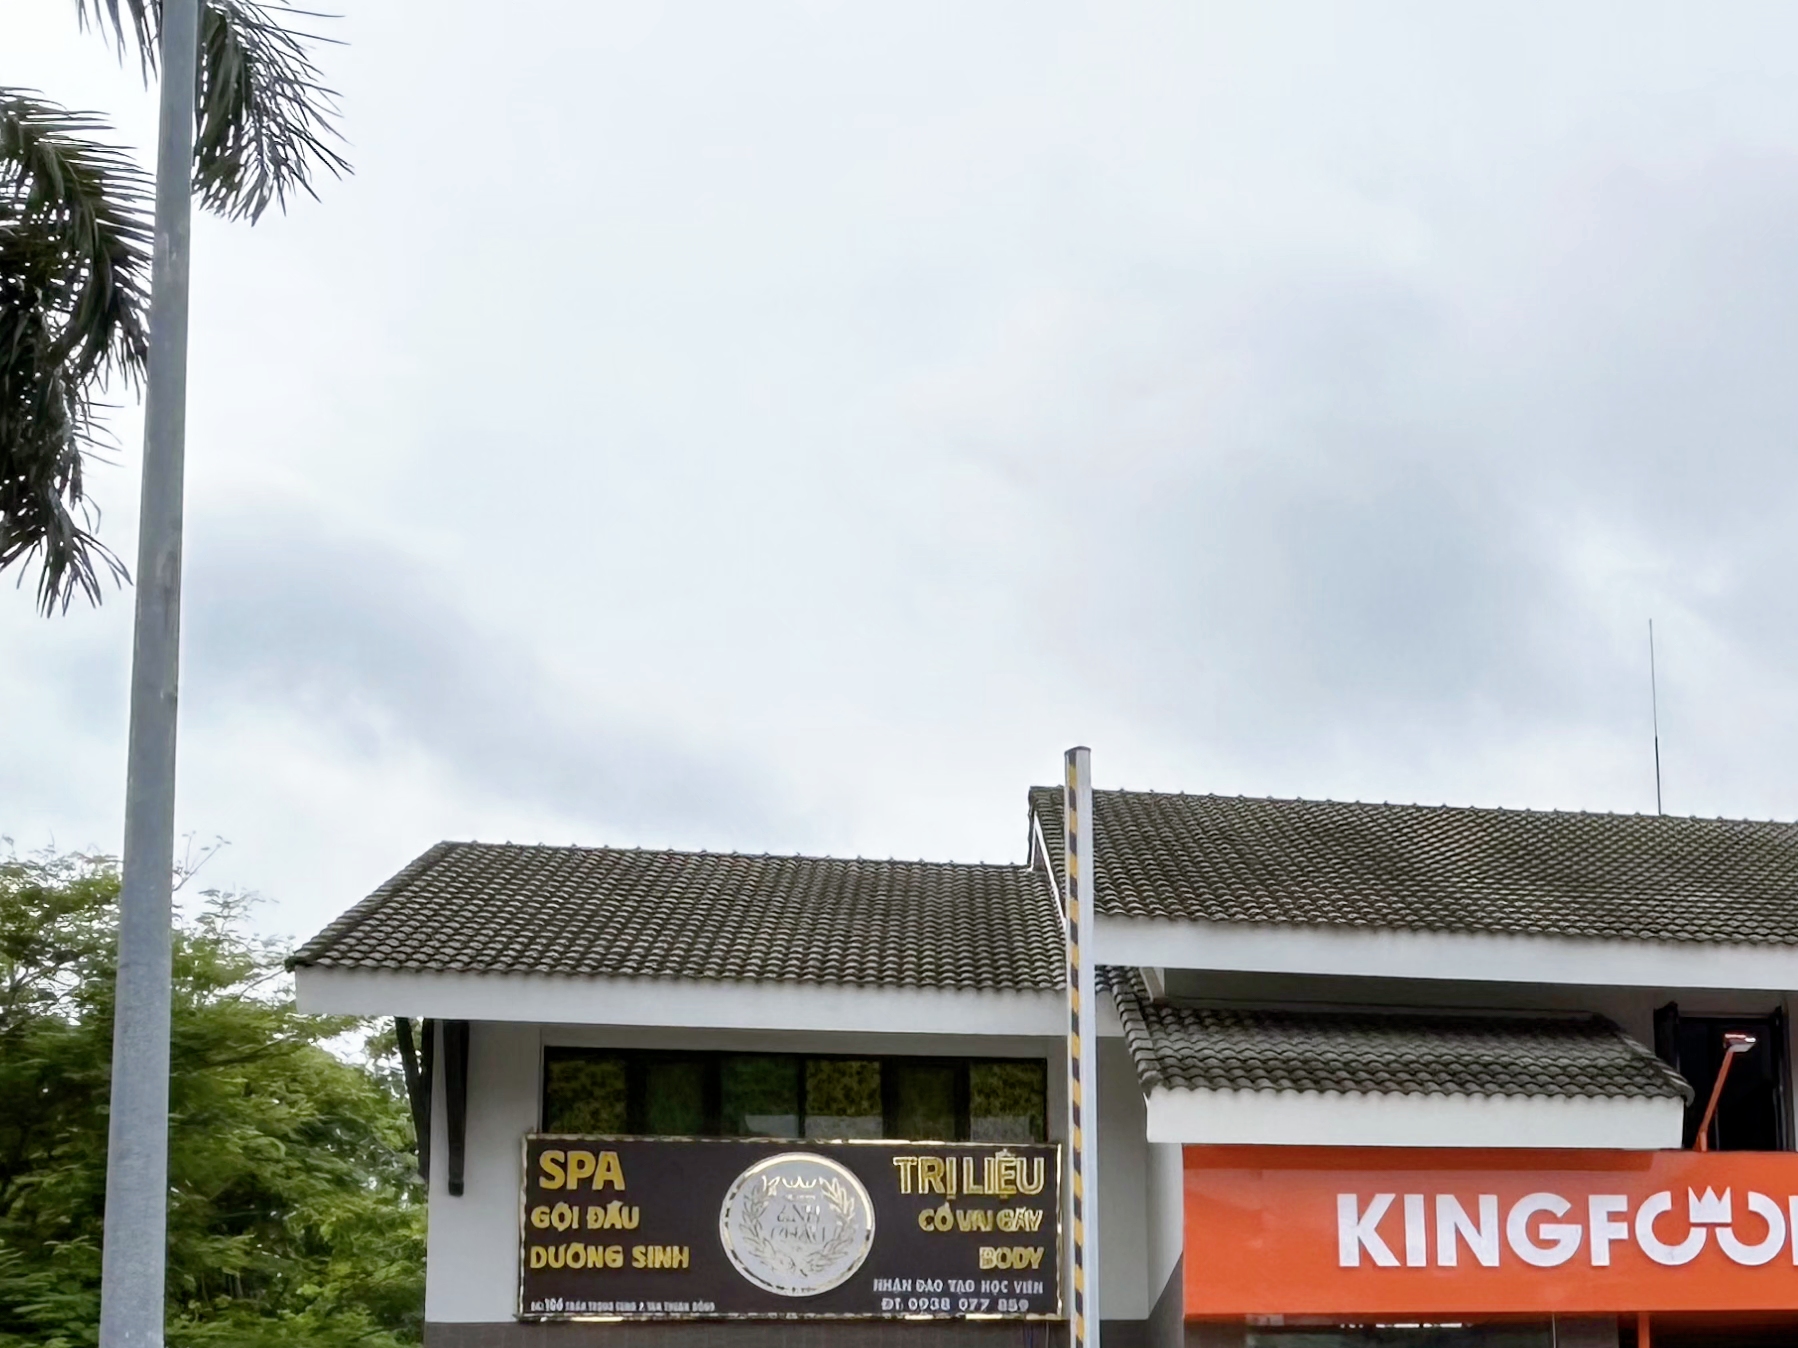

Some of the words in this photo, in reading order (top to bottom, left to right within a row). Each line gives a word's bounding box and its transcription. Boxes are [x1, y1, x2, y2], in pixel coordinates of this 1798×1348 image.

[538, 1150, 626, 1191] SPA
[892, 1156, 957, 1199] TRỊ
[962, 1148, 1045, 1199] LIỆU
[530, 1201, 580, 1232] GỘI
[956, 1208, 994, 1232] VAI
[631, 1245, 690, 1269] SINH
[978, 1246, 1044, 1269] BODY
[981, 1279, 1009, 1296] HỌC
